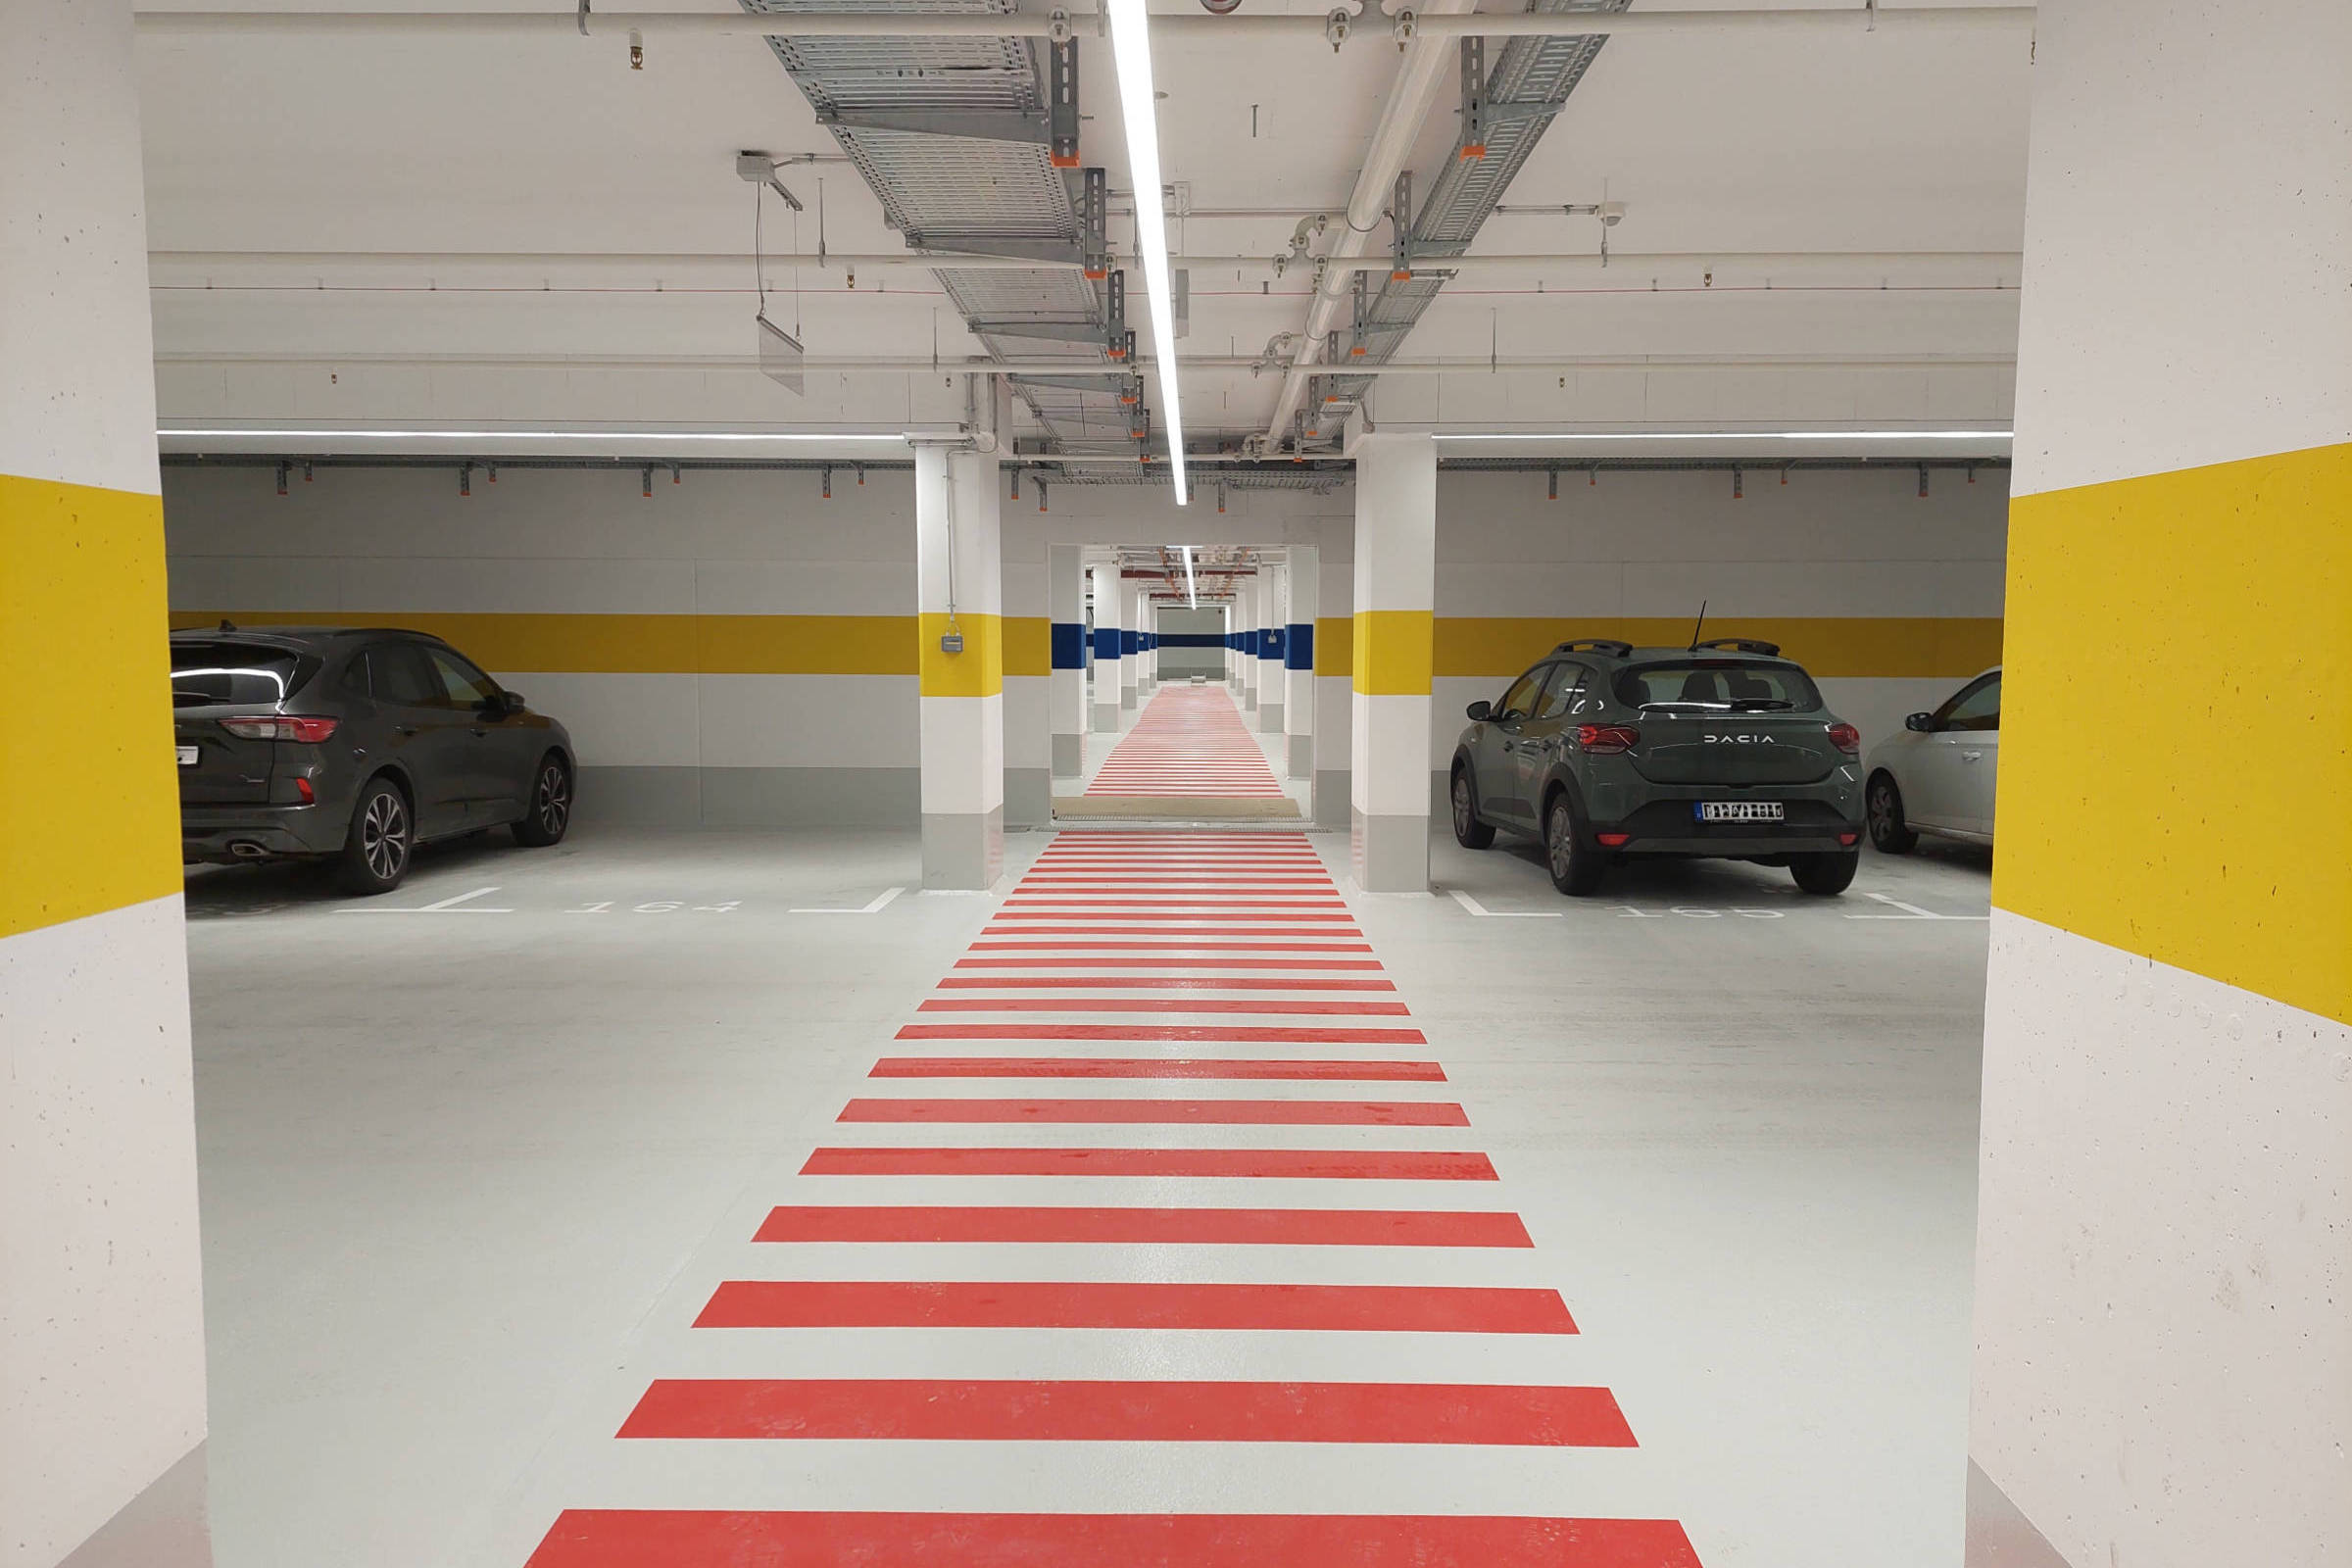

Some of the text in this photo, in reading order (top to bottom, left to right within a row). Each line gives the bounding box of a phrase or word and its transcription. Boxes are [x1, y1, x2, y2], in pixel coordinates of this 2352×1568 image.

[1703, 734, 1775, 744] DACIA
[564, 901, 744, 913] 164
[1604, 906, 1786, 918] 165
